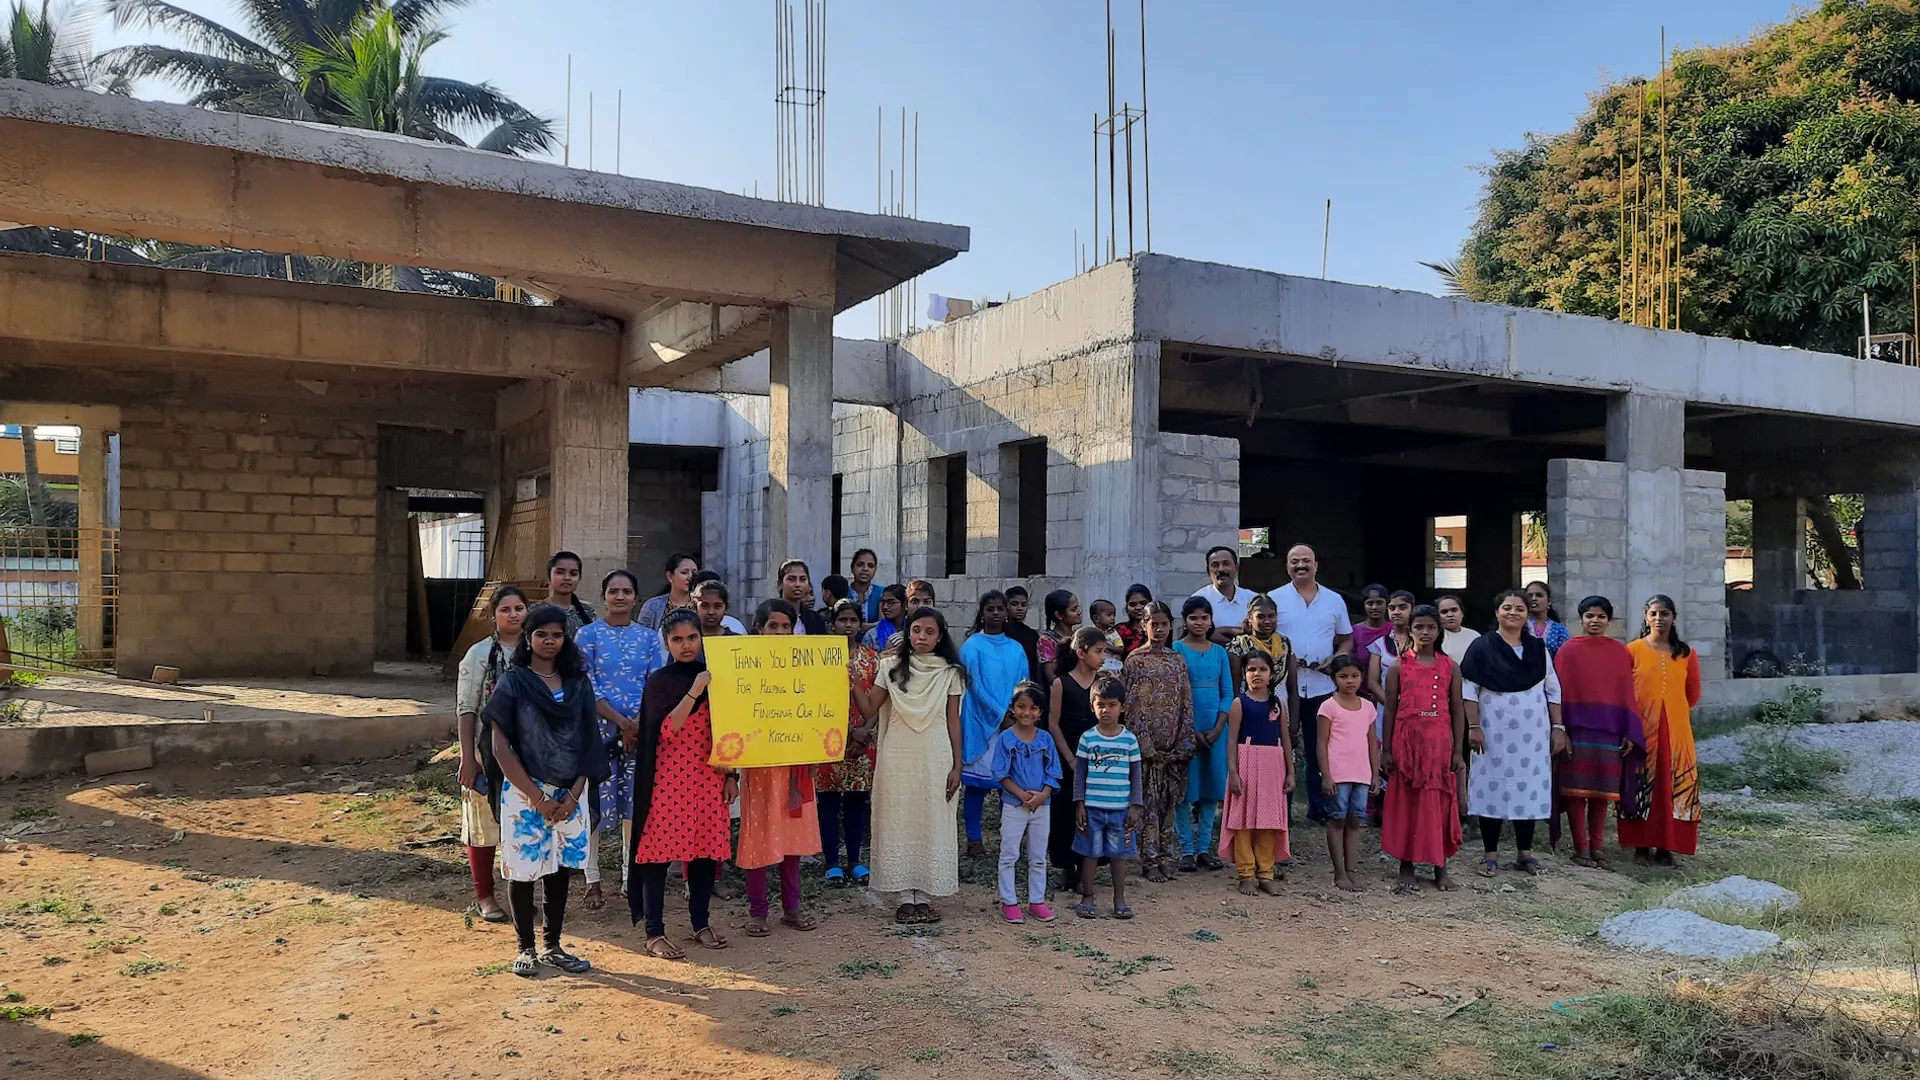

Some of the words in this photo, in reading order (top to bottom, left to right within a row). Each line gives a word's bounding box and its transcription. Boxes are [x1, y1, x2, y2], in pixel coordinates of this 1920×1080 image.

[791, 647, 815, 668] BNN
[818, 646, 843, 667] VARA
[736, 678, 752, 695] FOR
[768, 728, 804, 743] KITCHEN
